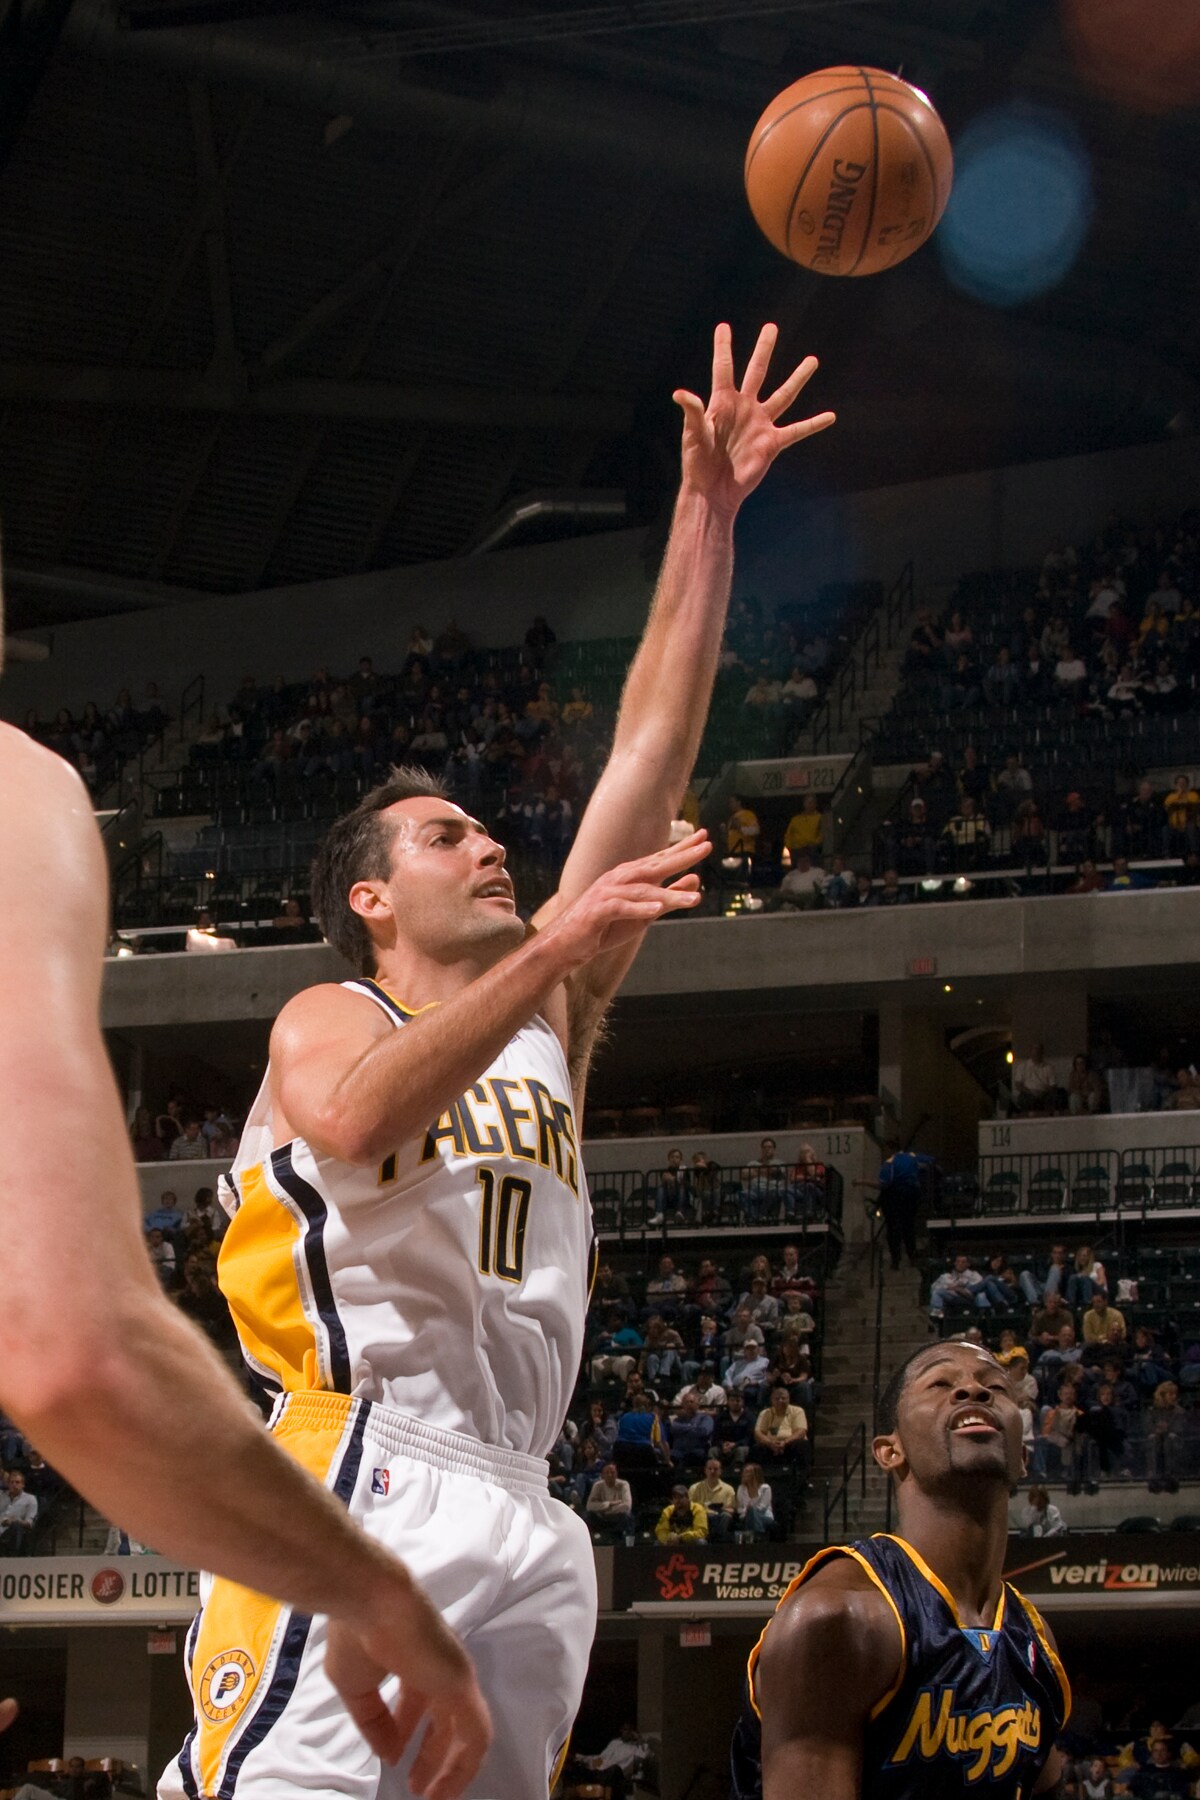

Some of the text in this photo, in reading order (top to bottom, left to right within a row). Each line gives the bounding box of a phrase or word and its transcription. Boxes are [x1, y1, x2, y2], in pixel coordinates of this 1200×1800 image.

[814, 768, 834, 786] 221
[378, 1077, 579, 1201] ACERS
[827, 1135, 851, 1155] 113
[992, 1126, 1011, 1147] 114
[476, 1165, 532, 1285] 10
[1050, 1559, 1159, 1588] verizon
[0, 1573, 84, 1599] OOSIER
[716, 1585, 763, 1599] Waste
[203, 1653, 254, 1682] INDIANA
[203, 1696, 245, 1719] PACERS
